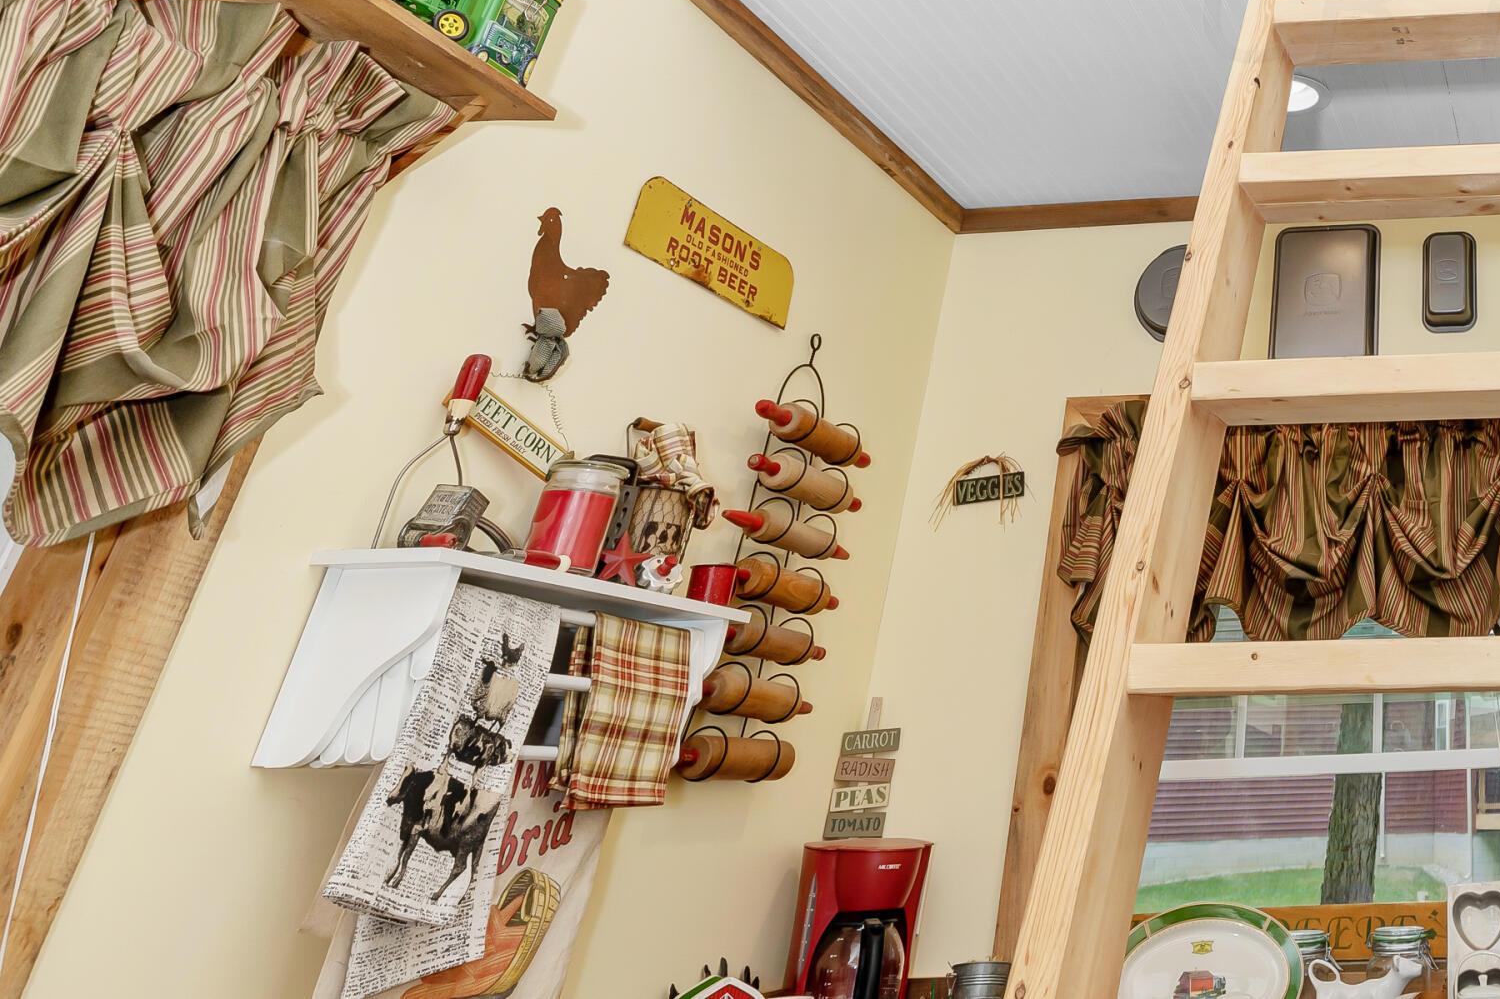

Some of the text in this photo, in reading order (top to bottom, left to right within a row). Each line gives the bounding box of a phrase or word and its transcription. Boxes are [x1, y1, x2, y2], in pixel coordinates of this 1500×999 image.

[680, 205, 762, 271] MASON'S
[686, 233, 749, 277] OLD FASHIONED
[666, 236, 758, 301] ROOT BEER
[475, 394, 557, 464] EET CORN
[492, 423, 511, 442] FRESH
[957, 474, 1023, 503] VEGGES
[844, 730, 898, 751] CARROT
[840, 761, 890, 777] RADISH
[834, 785, 887, 809] PEAS
[831, 816, 881, 833] TOMATO
